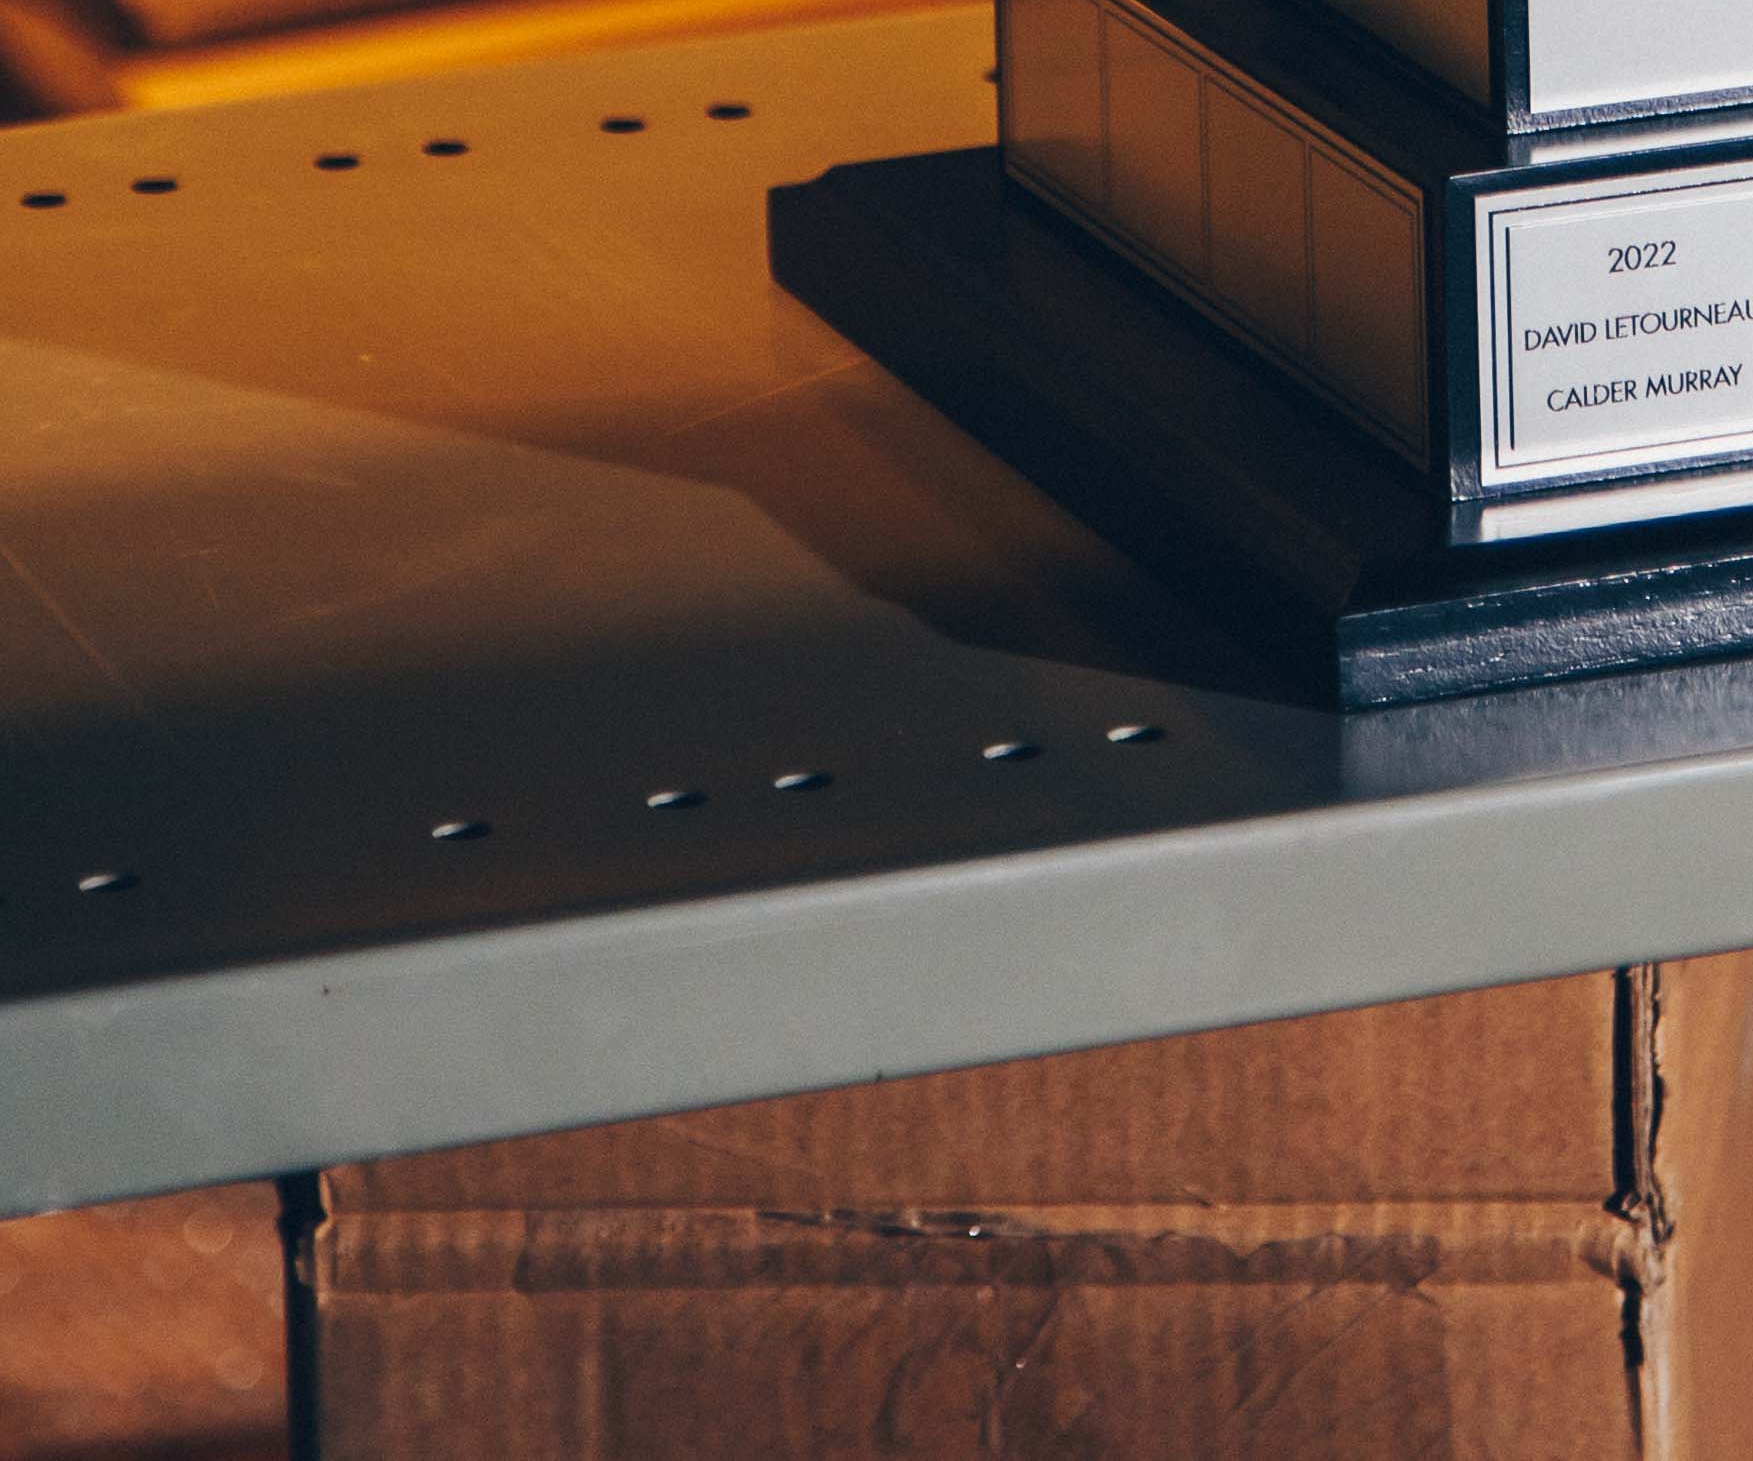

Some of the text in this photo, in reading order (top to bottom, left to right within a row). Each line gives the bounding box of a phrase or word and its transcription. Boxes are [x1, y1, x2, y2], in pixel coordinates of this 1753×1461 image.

[1607, 240, 1677, 274] 2022
[1524, 321, 1597, 351] DAVID
[1546, 363, 1744, 412] CALDER MURRAY
